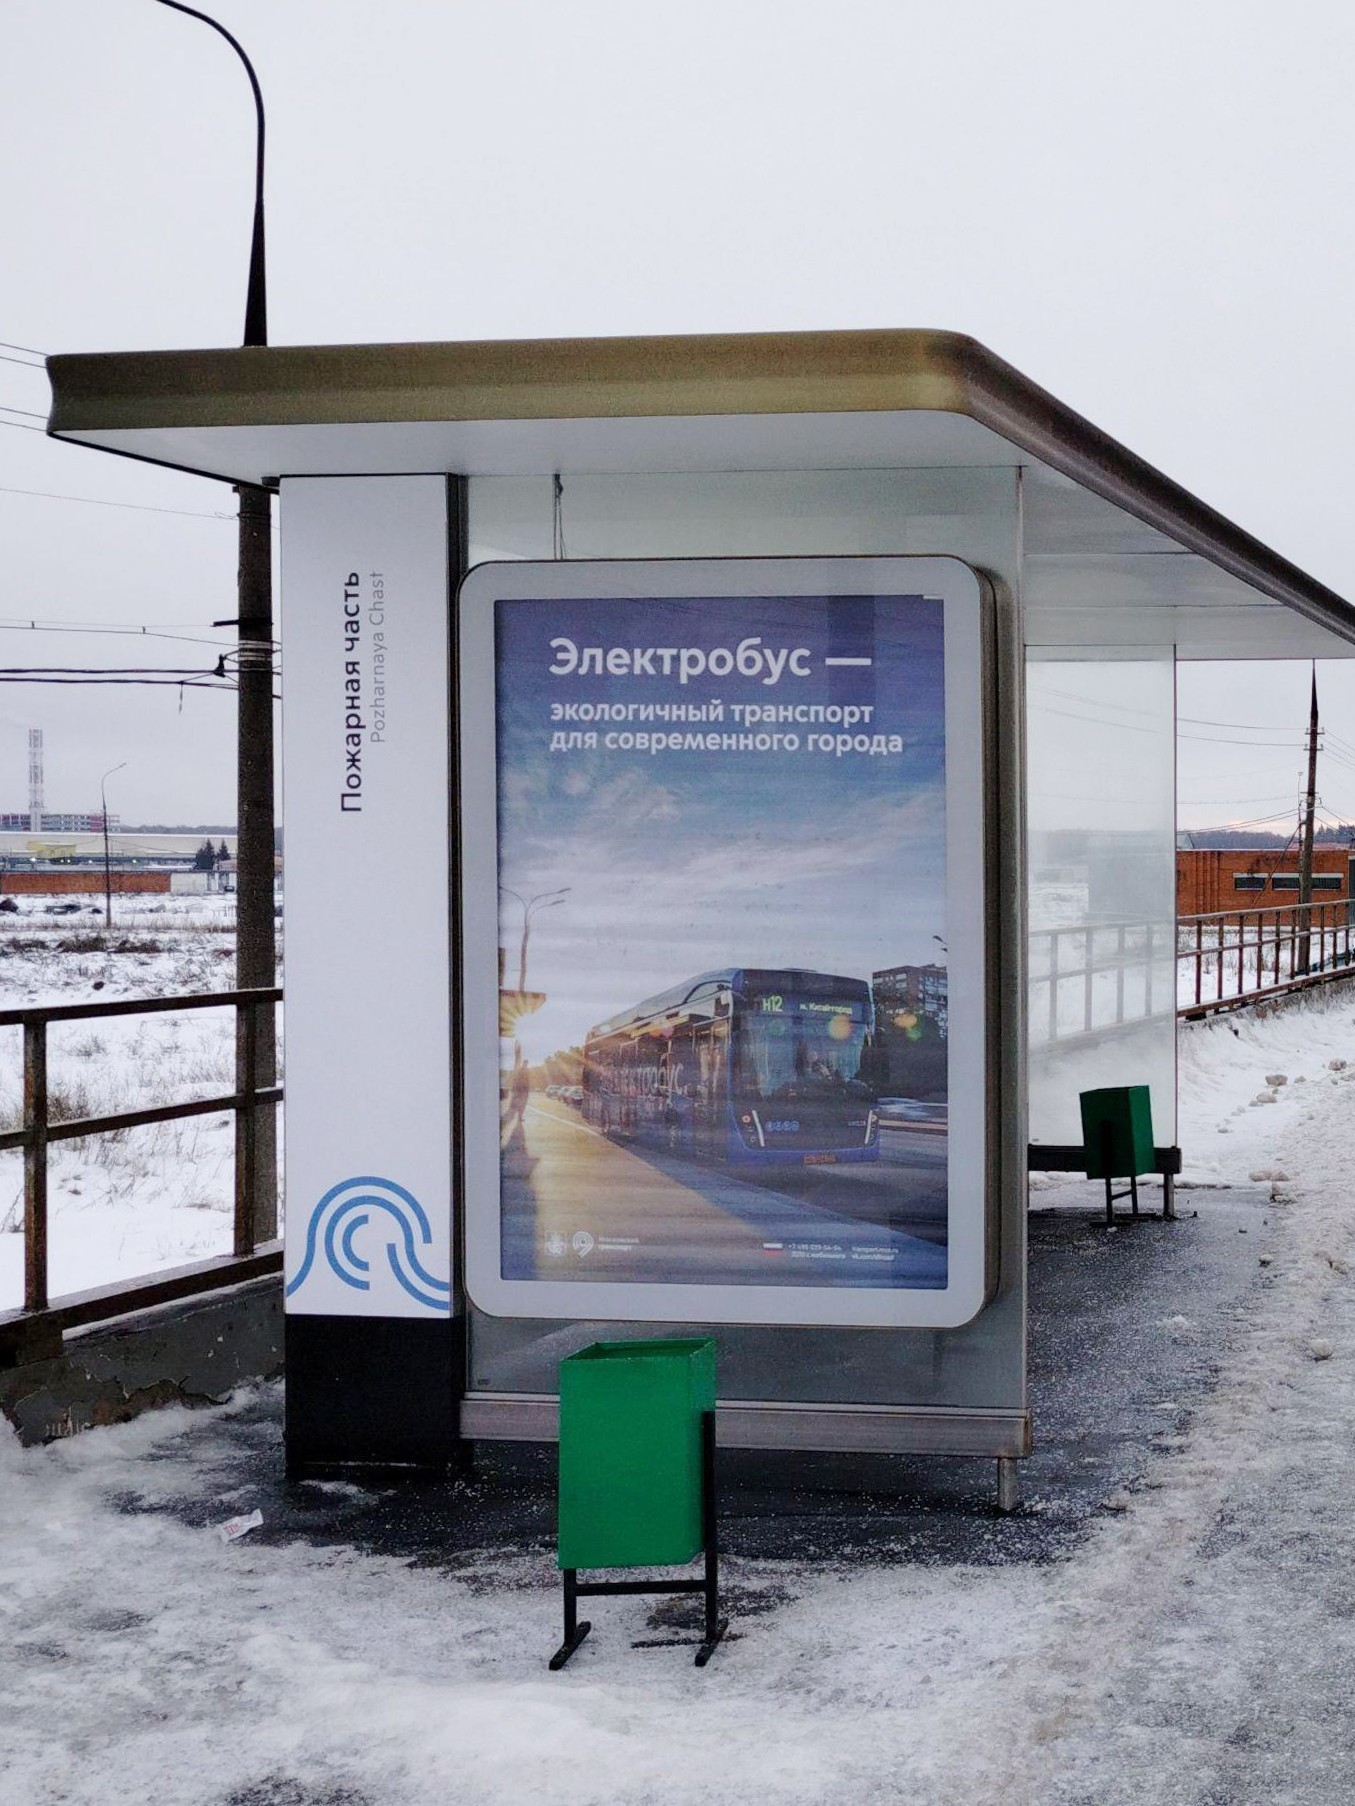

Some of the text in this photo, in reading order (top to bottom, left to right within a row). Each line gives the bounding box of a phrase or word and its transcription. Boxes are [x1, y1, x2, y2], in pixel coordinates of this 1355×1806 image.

[369, 571, 388, 743] Pozharnaya Chast
[549, 637, 811, 685] Электробус
[341, 572, 366, 812] Пожарная часть
[550, 700, 874, 726] экологичный транспорт
[549, 731, 903, 757] для современного города
